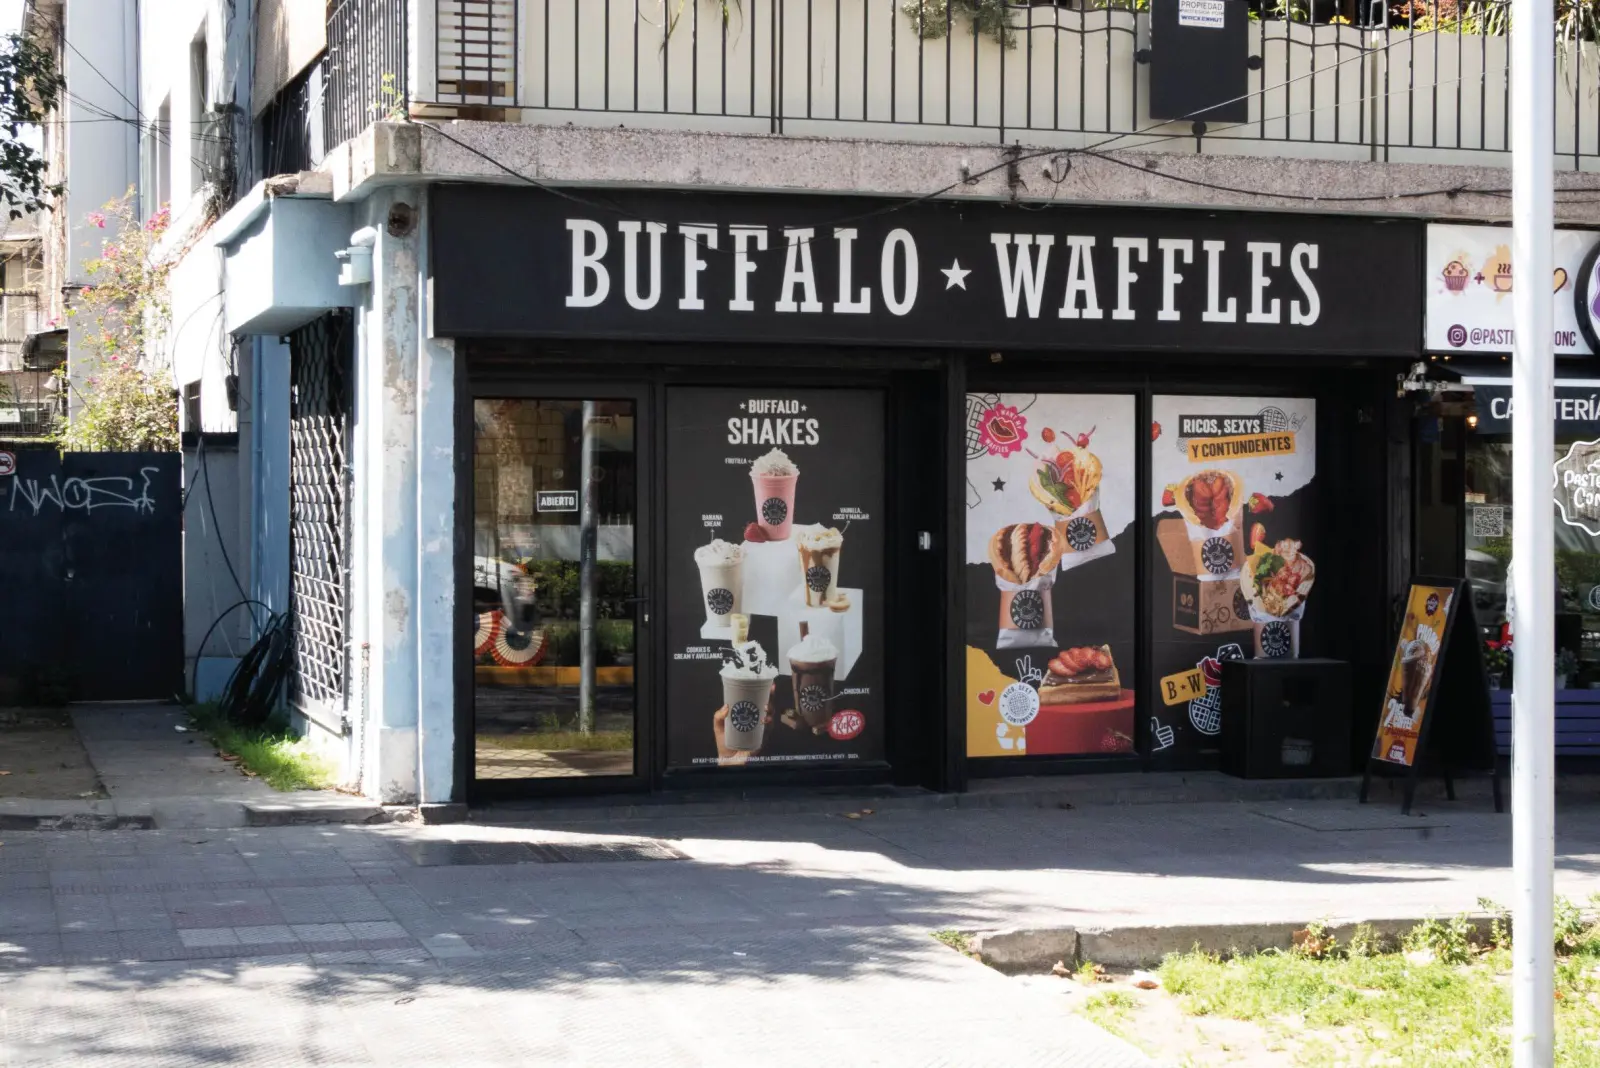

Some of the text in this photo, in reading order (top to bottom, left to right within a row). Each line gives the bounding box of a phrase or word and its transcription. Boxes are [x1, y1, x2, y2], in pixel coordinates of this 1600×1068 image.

[1180, 0, 1223, 10] PROPIEDAD
[565, 218, 1321, 326] BUFFALO WAFFLES
[748, 400, 799, 414] BUFFALO
[727, 417, 820, 446] SHAKES
[1183, 418, 1261, 435] RICOS, SEXYS
[1191, 436, 1292, 459] Y CONTUNDENTES
[540, 495, 576, 507] ABIERTO
[1067, 517, 1093, 530] BUFFALO
[1202, 538, 1231, 549] BUFFALO
[843, 687, 870, 695] CHOCOLATE
[1166, 672, 1201, 700] B W
